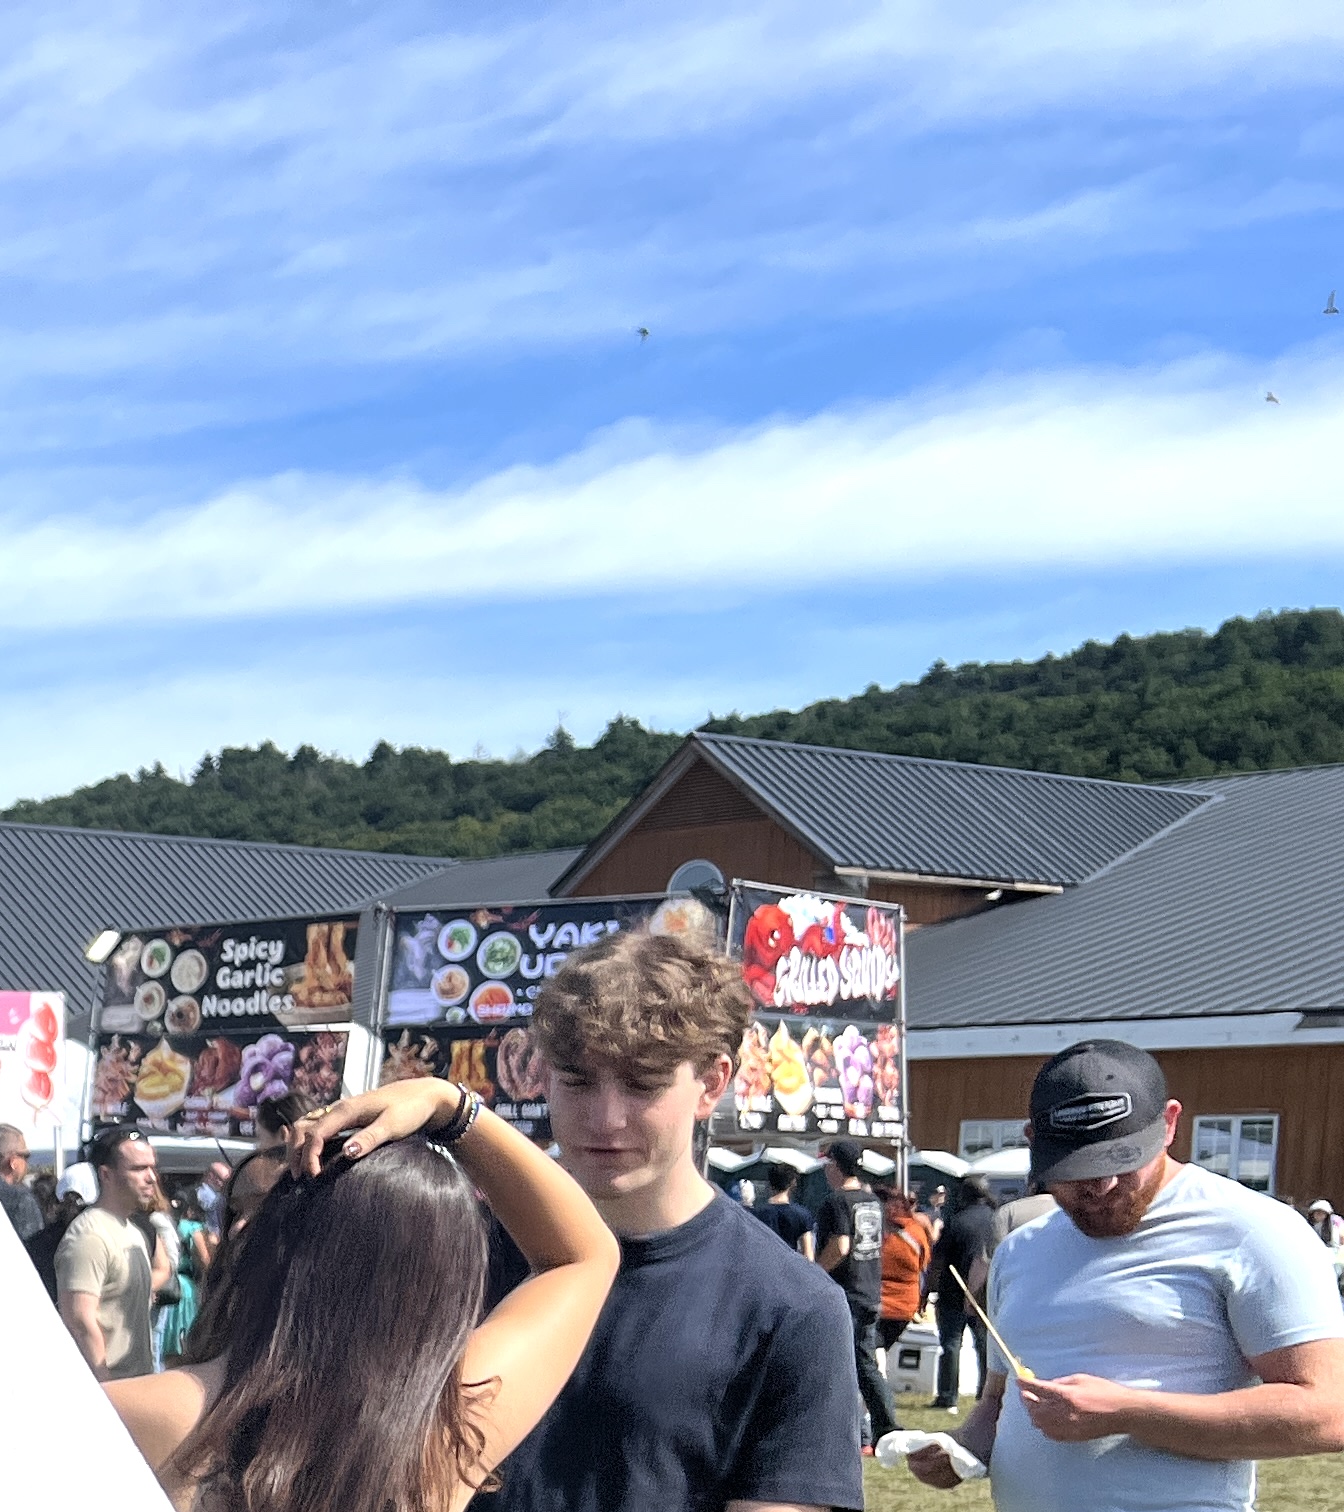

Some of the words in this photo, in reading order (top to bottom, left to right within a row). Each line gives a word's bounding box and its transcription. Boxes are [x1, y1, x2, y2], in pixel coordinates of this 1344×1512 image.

[220, 936, 284, 967] Spicy
[216, 962, 284, 990] Garlic
[202, 989, 296, 1018] Noodles
